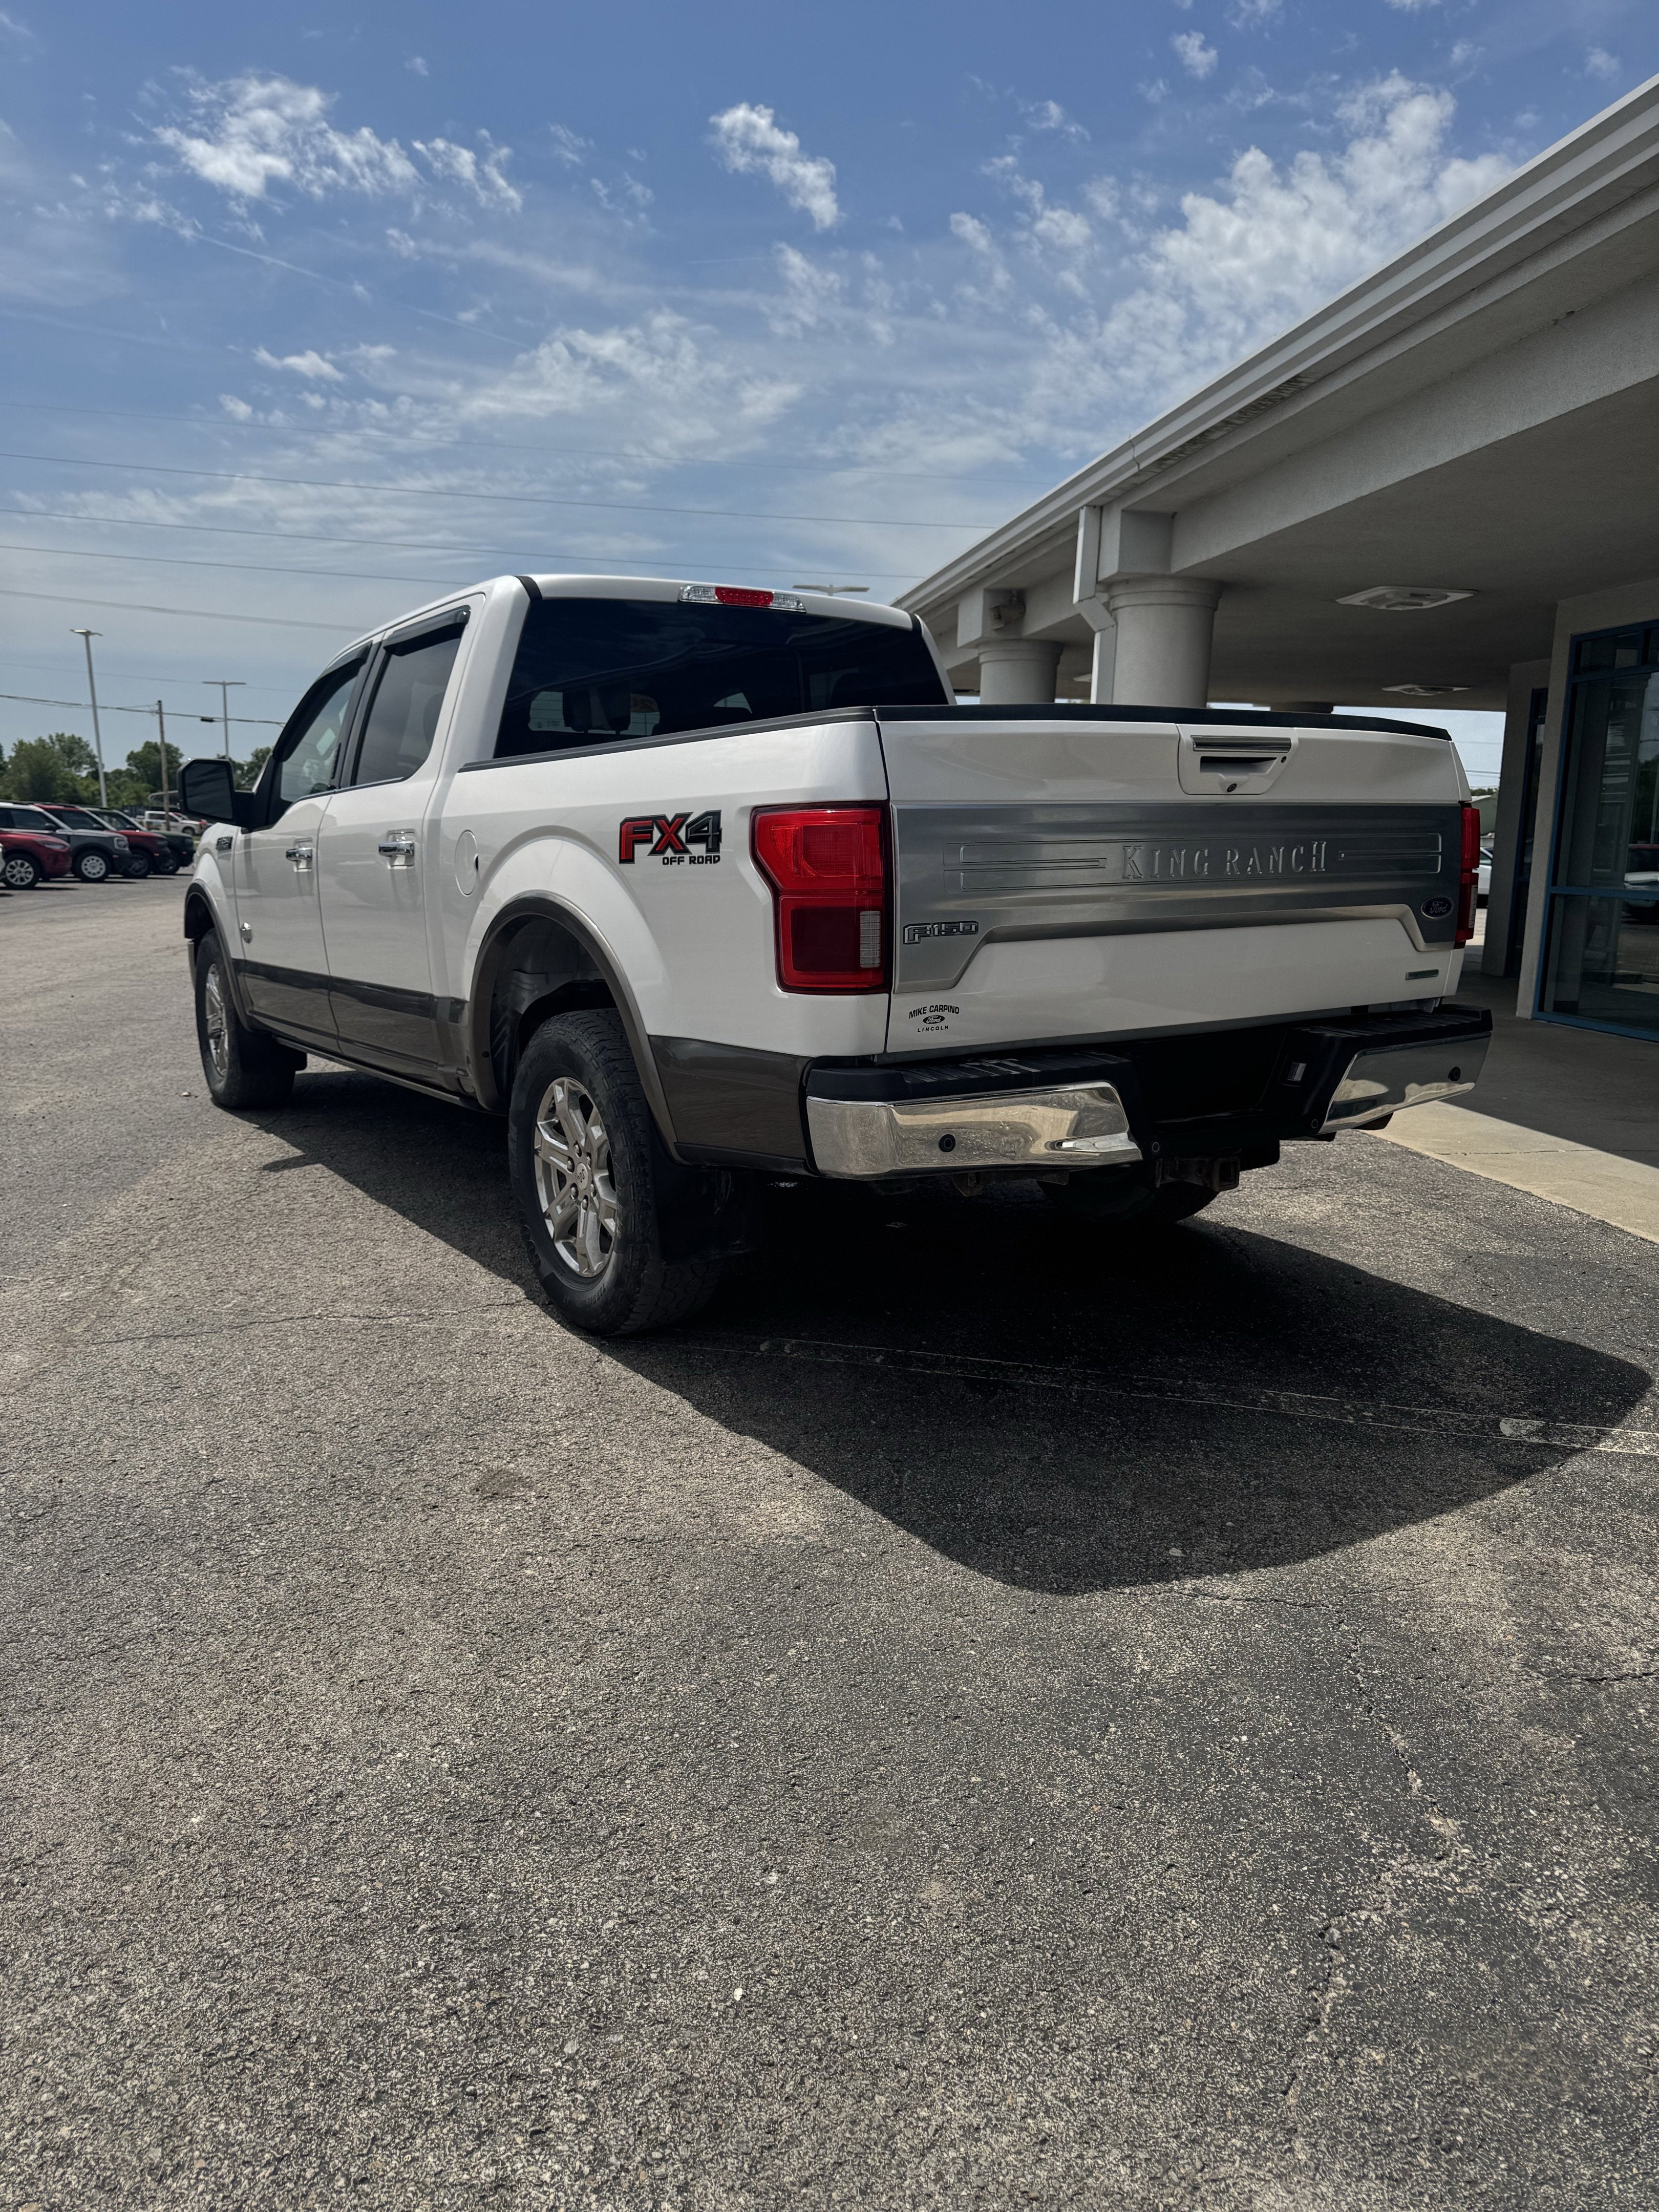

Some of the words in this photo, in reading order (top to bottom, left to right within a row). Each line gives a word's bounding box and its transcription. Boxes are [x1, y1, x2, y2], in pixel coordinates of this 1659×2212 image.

[619, 810, 722, 864] FX4
[662, 856, 685, 865] OFF
[689, 855, 720, 865] ROAD
[1122, 845, 1209, 879] KING
[1226, 841, 1327, 875] RANCH
[908, 1006, 927, 1019] MIKE
[929, 1005, 960, 1014] CARPINO
[926, 1015, 942, 1024] Ford
